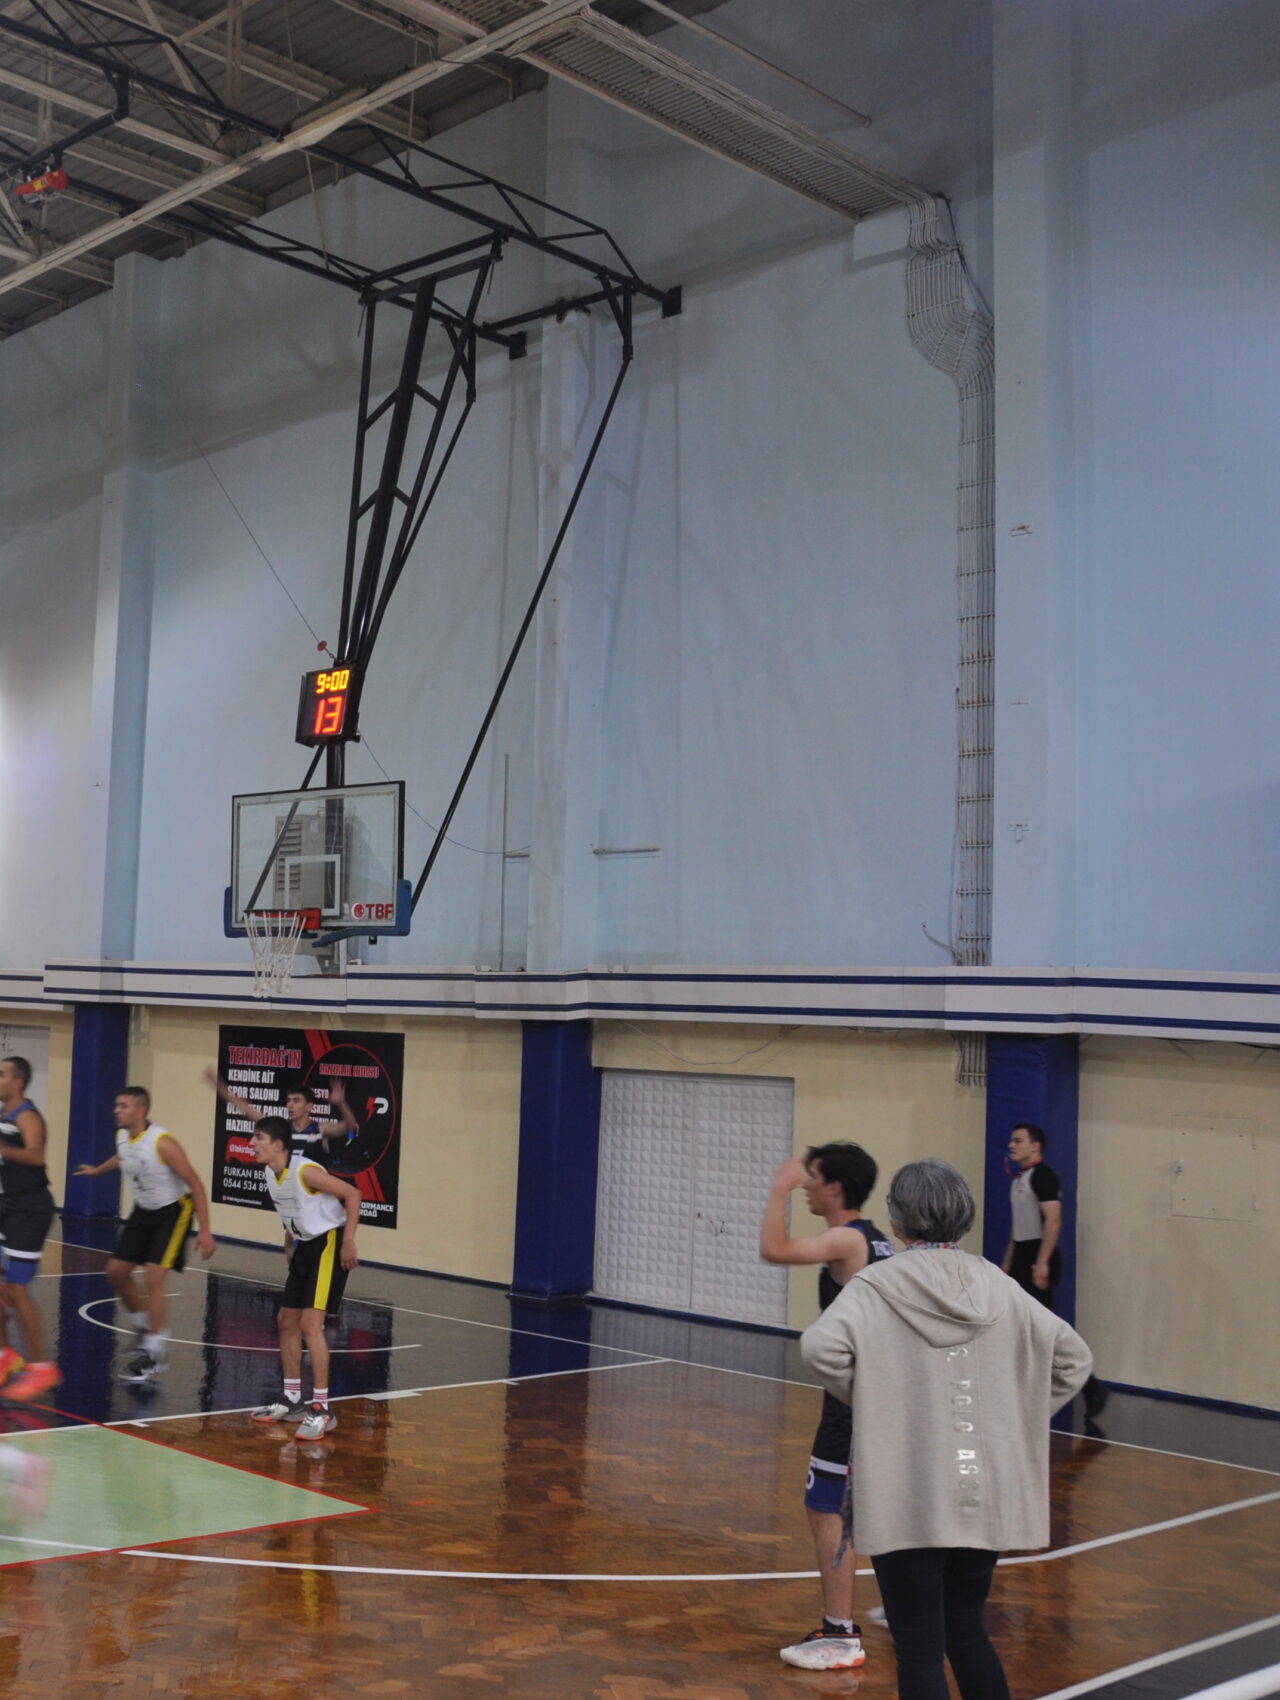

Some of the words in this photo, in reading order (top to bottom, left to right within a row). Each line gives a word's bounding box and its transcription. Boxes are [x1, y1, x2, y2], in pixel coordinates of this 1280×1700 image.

[315, 669, 350, 694] 9:00
[314, 696, 343, 735] 13
[366, 904, 394, 919] TBF
[228, 1044, 302, 1069] TEKİRDAĞ'IN
[228, 1068, 261, 1083] KENDİNE
[261, 1070, 275, 1084] AİT
[227, 1086, 248, 1099] SPOR
[249, 1087, 280, 1102] SALONU
[224, 1166, 252, 1178] FURKAN
[223, 1178, 241, 1189] 0544
[242, 1180, 257, 1190] 534
[949, 1379, 974, 1433] POLO
